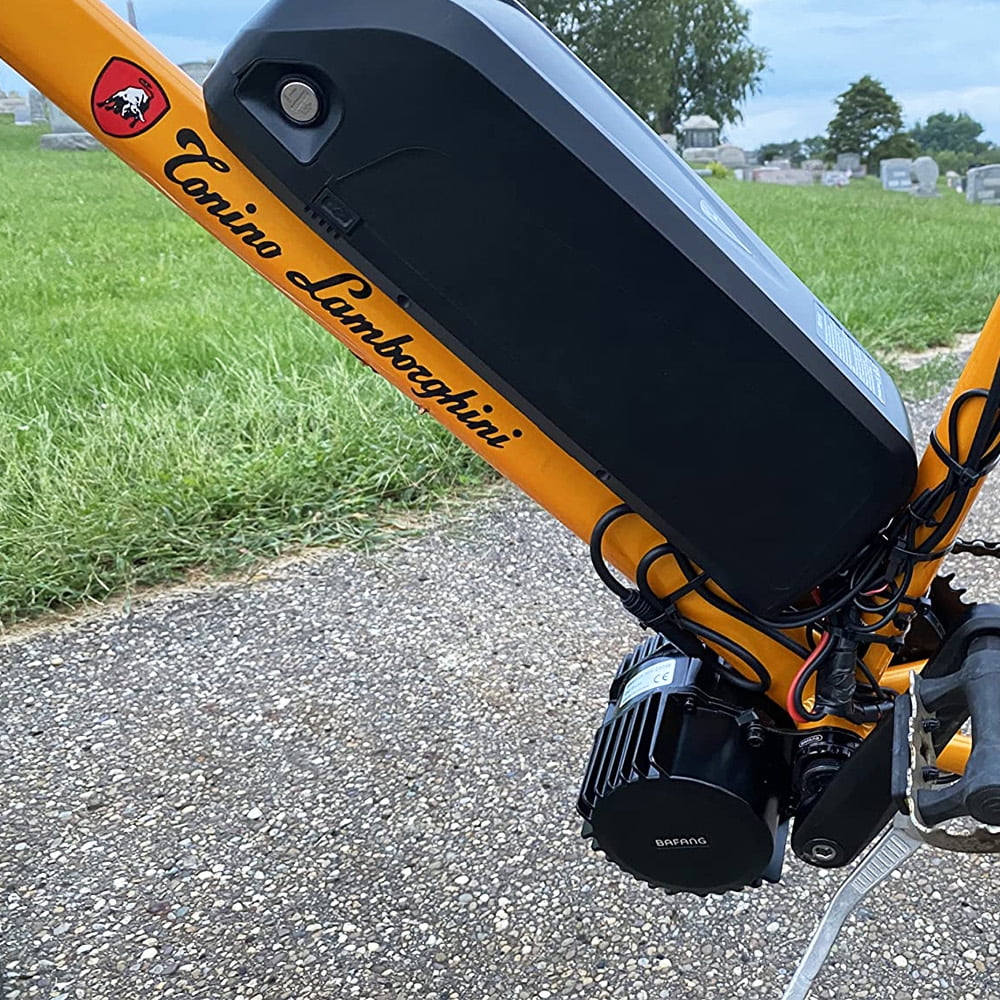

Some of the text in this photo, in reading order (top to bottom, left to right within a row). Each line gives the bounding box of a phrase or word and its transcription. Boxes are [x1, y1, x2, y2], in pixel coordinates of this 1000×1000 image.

[163, 127, 523, 449] Tonino Lamborghini
[655, 836, 707, 847] BAFANG
